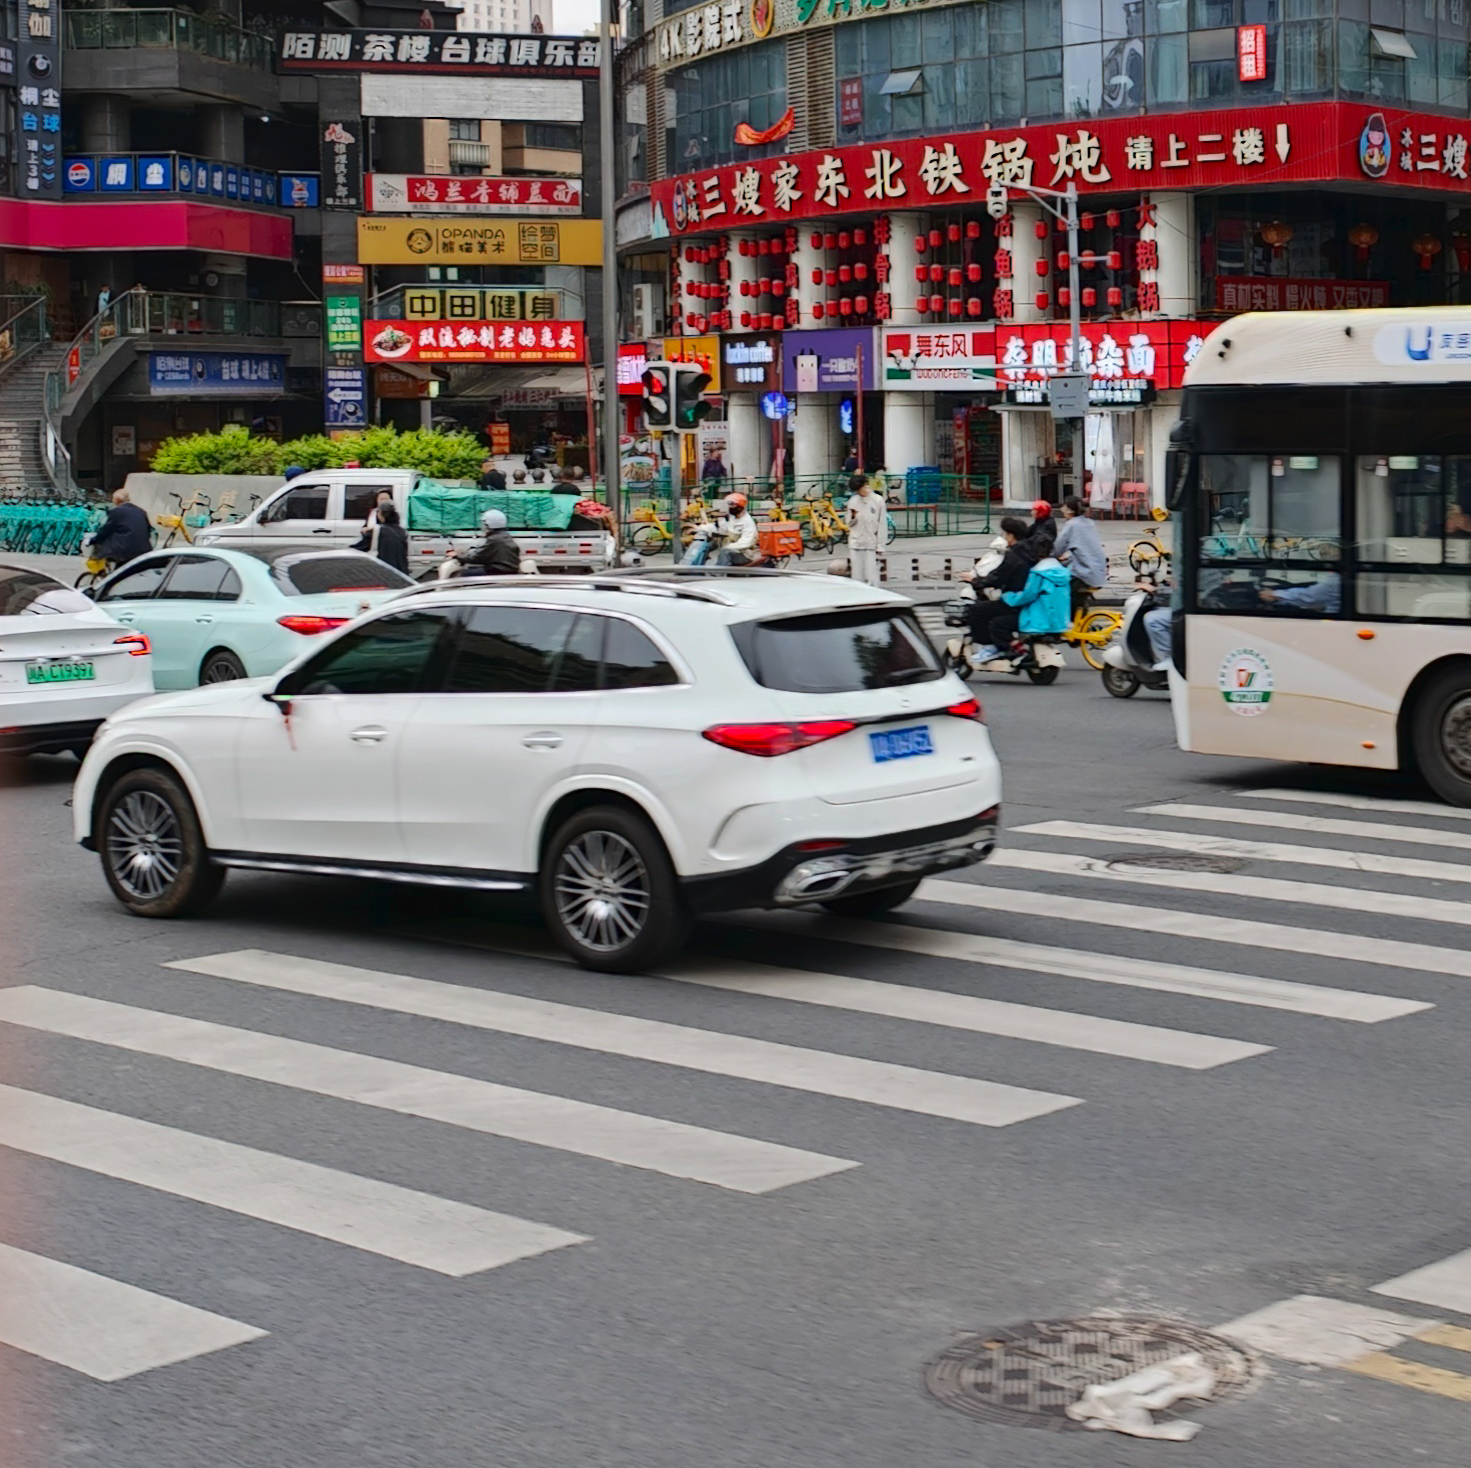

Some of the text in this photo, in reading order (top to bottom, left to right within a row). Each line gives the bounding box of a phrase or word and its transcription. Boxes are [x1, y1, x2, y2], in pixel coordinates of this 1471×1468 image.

[21, 111, 61, 133] 台球
[701, 130, 1112, 222] 三嫂家东北铁锅炖
[1124, 127, 1267, 171] 请上二楼
[441, 240, 506, 255] 熊猫美术
[1135, 195, 1159, 313] 大鹅锅
[873, 214, 893, 320] 排骨锅
[409, 294, 556, 320] 中田健身
[1222, 282, 1281, 311] 真材实料
[916, 333, 969, 359] 舞东风
